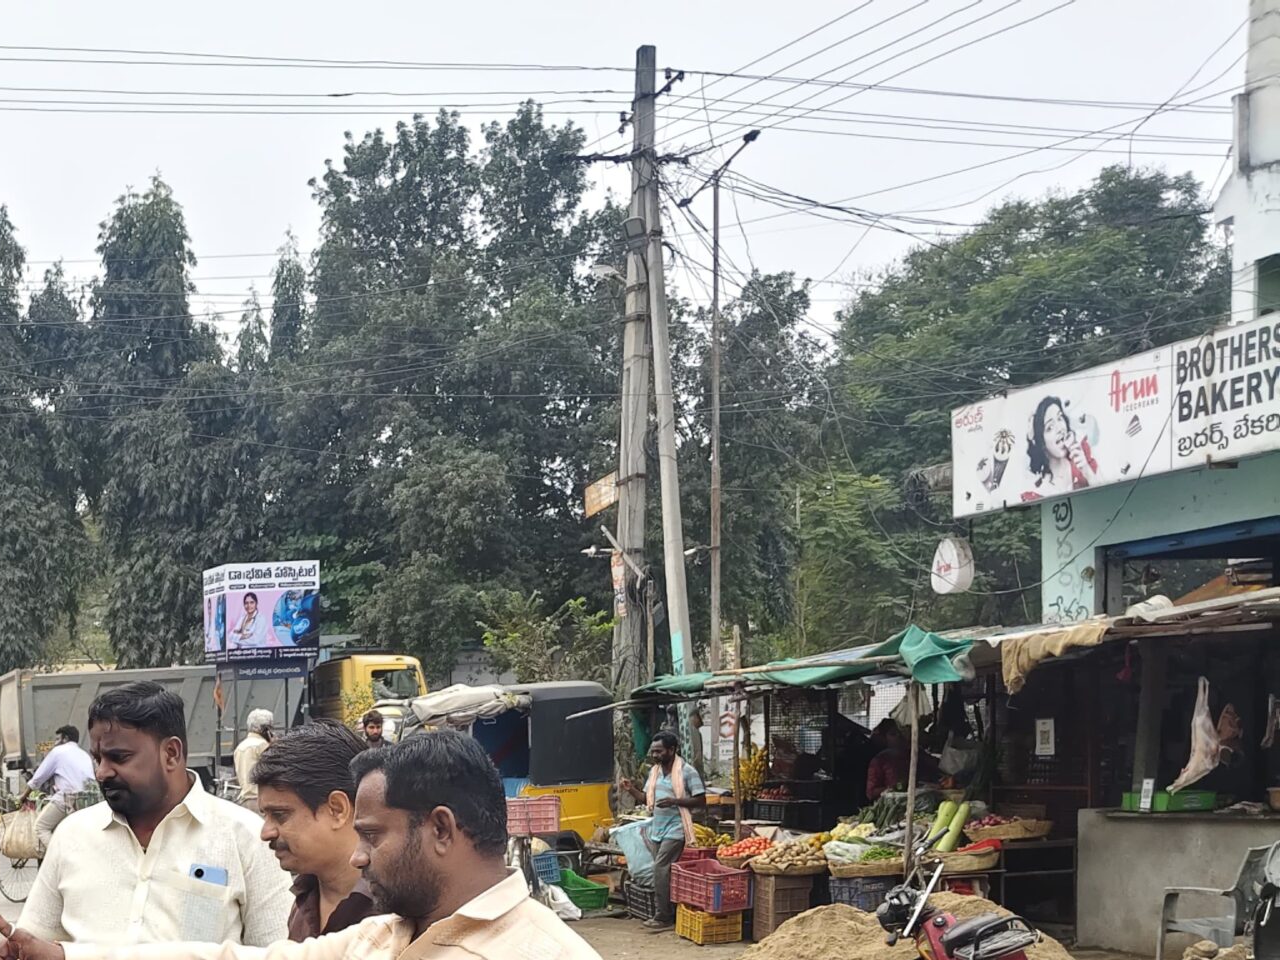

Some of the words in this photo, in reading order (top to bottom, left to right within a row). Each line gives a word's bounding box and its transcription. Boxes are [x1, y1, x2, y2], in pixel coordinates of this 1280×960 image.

[1176, 322, 1280, 385] BROTHERS
[1108, 370, 1159, 413] Arun
[1123, 398, 1159, 413] ICECREAMS
[1178, 366, 1280, 423] BAKERY
[1177, 421, 1229, 457] బ్రదర్స్
